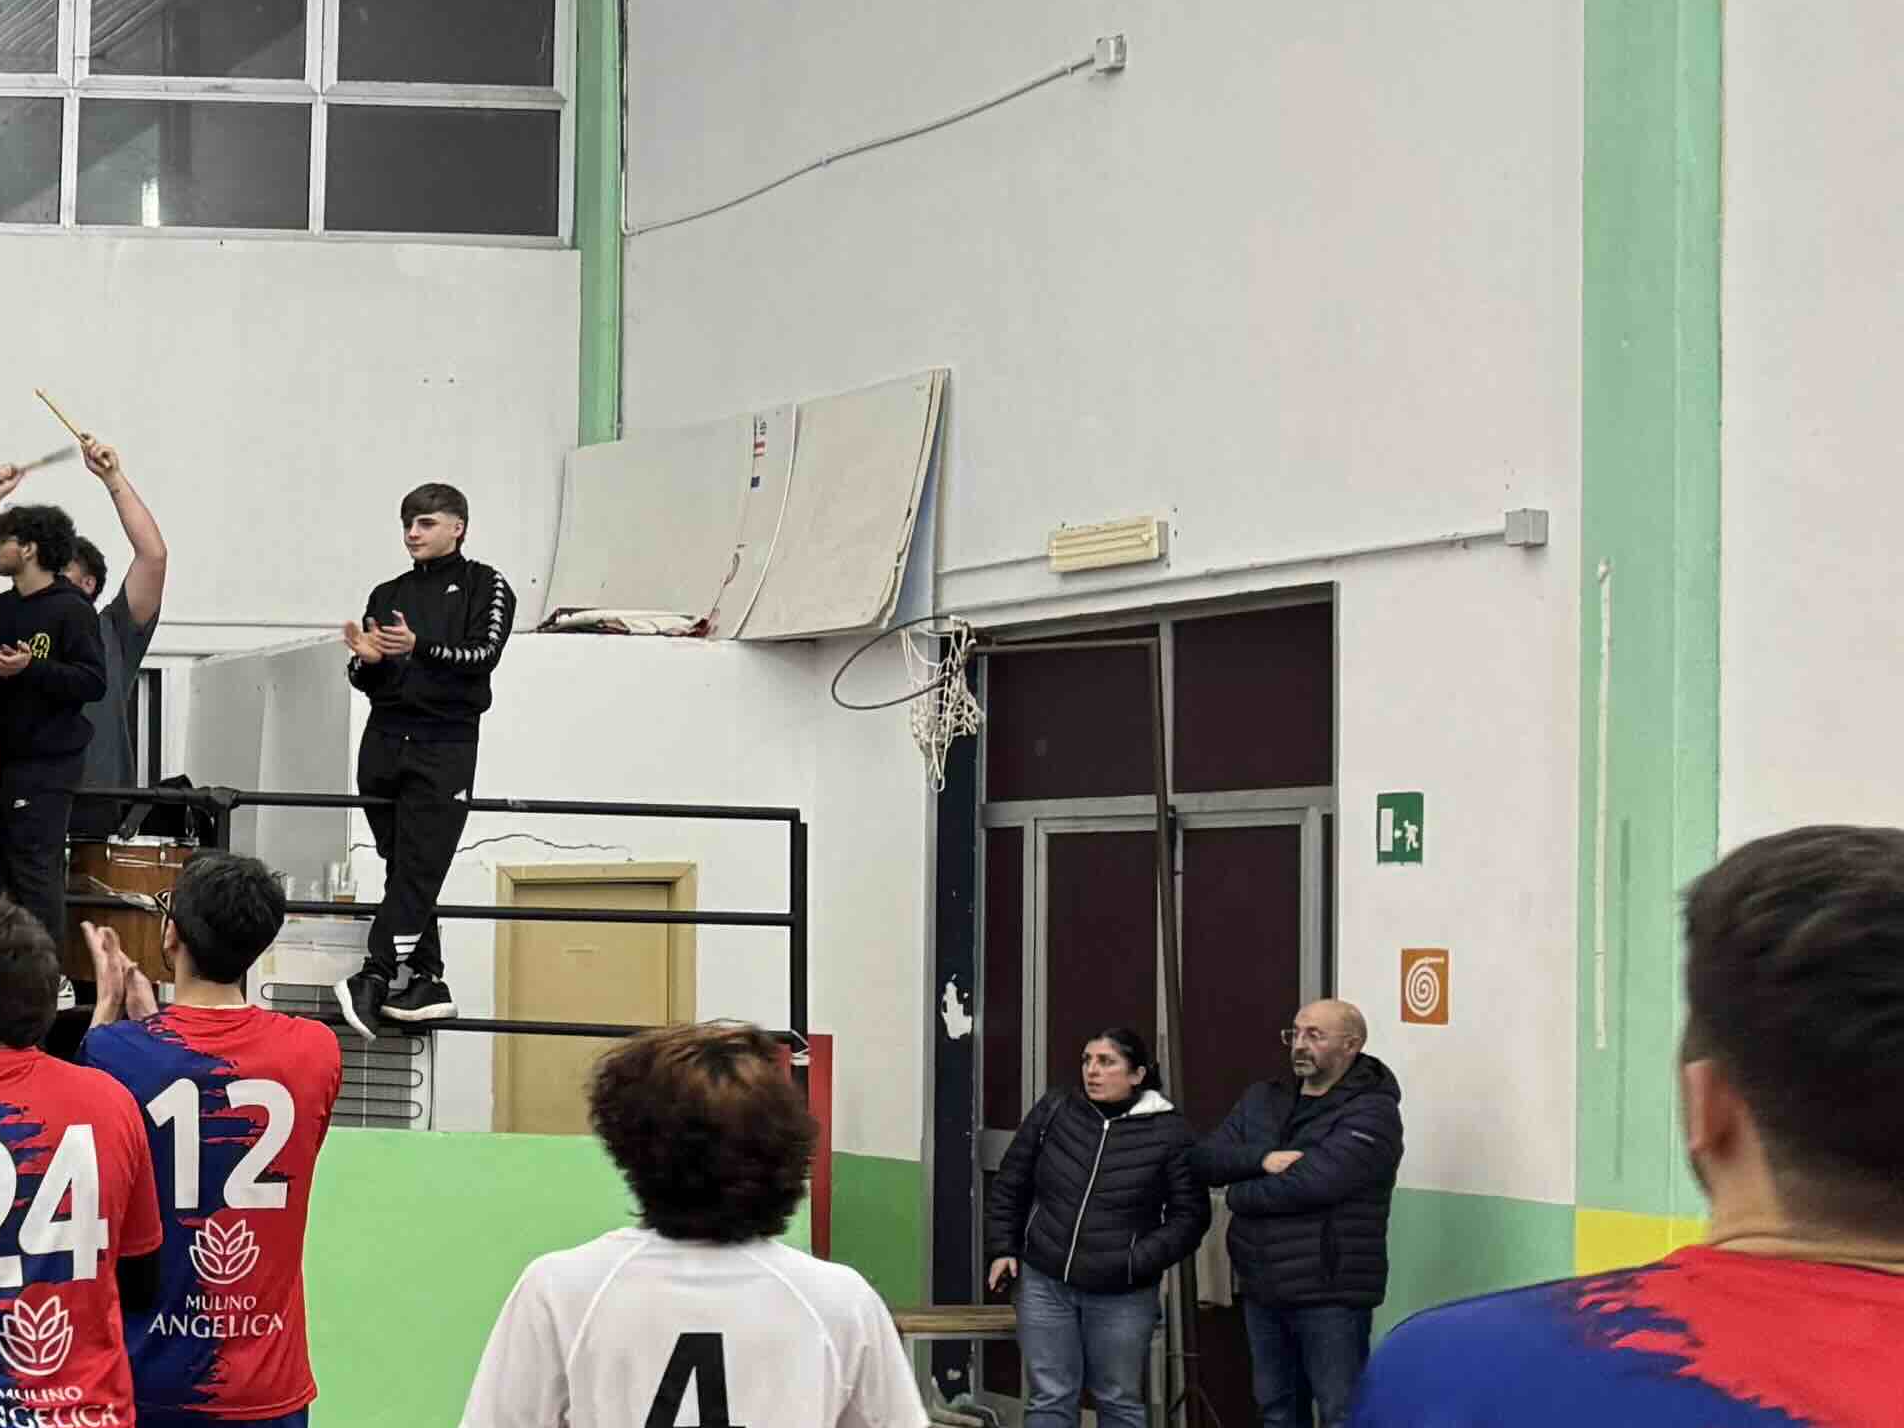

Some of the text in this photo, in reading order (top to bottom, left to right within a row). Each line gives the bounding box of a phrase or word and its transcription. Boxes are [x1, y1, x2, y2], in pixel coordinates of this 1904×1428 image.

[145, 1077, 296, 1210] 12
[185, 1294, 258, 1312] MULINO
[148, 1312, 285, 1339] ANGELICA
